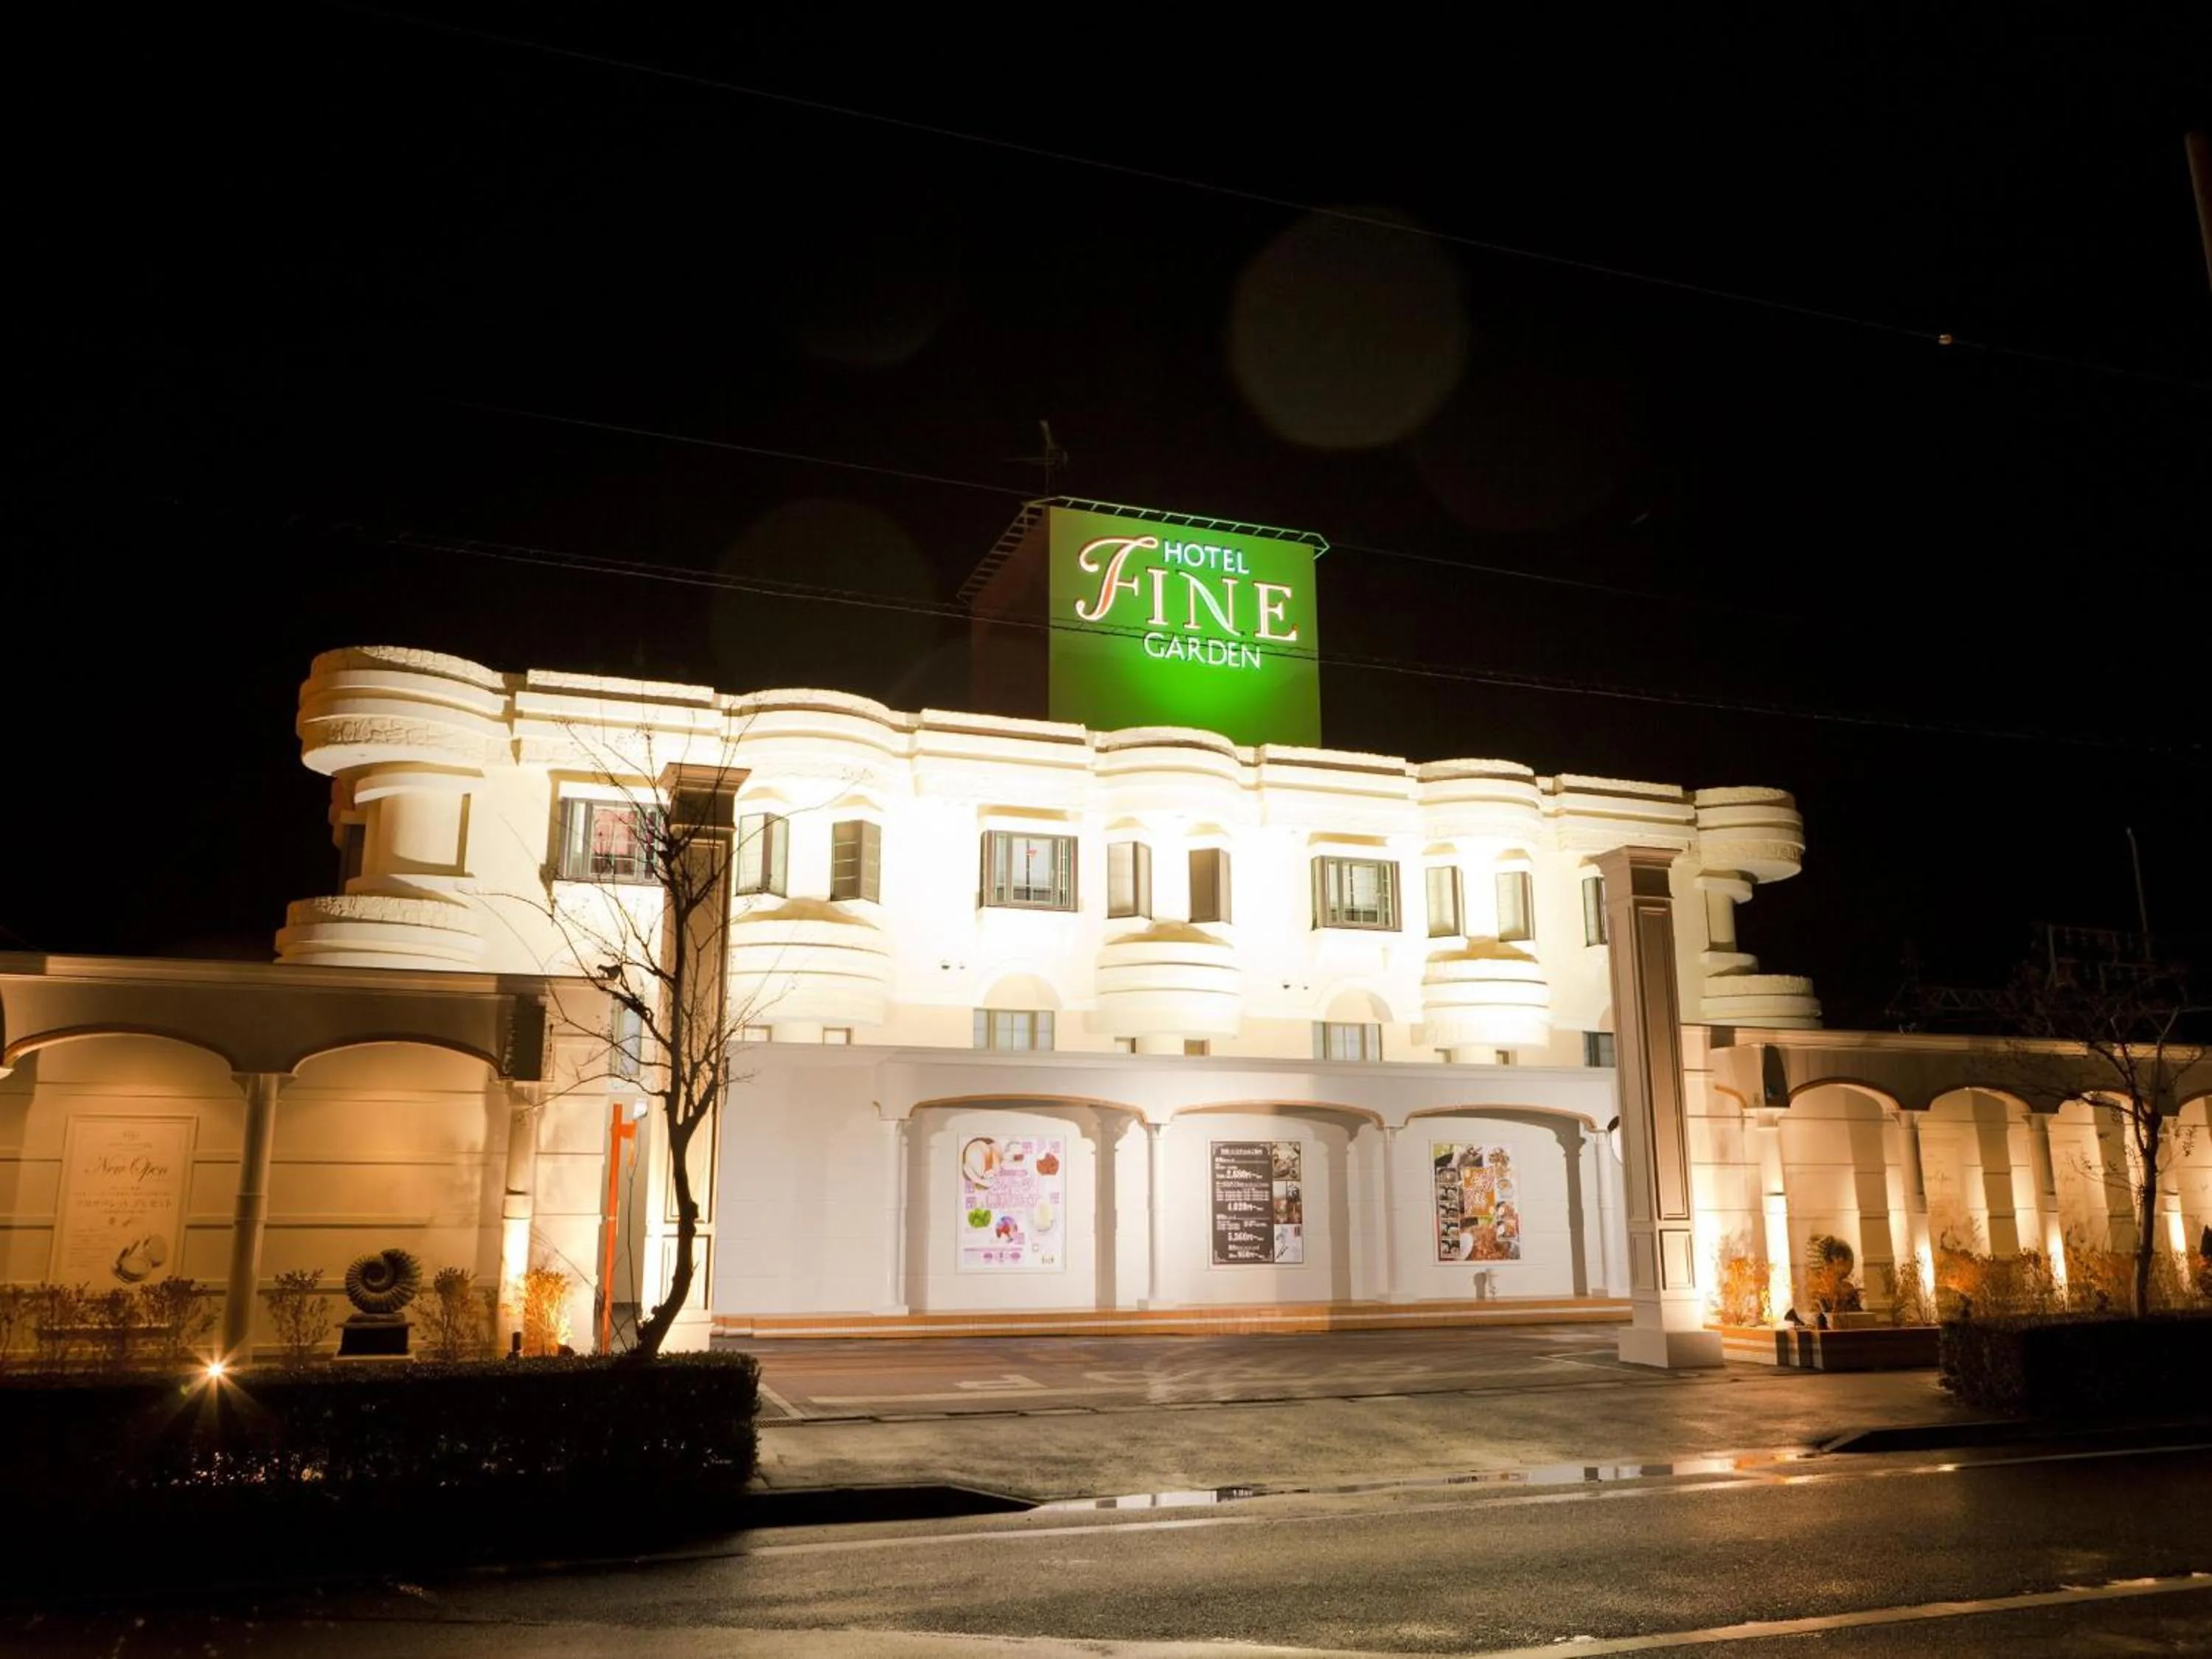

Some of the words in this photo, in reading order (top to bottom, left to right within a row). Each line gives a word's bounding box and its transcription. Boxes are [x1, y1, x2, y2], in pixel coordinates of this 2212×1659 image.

[1163, 540, 1249, 574] HOTEL
[1076, 536, 1297, 641] FINE
[1144, 632, 1261, 669] GARDEN
